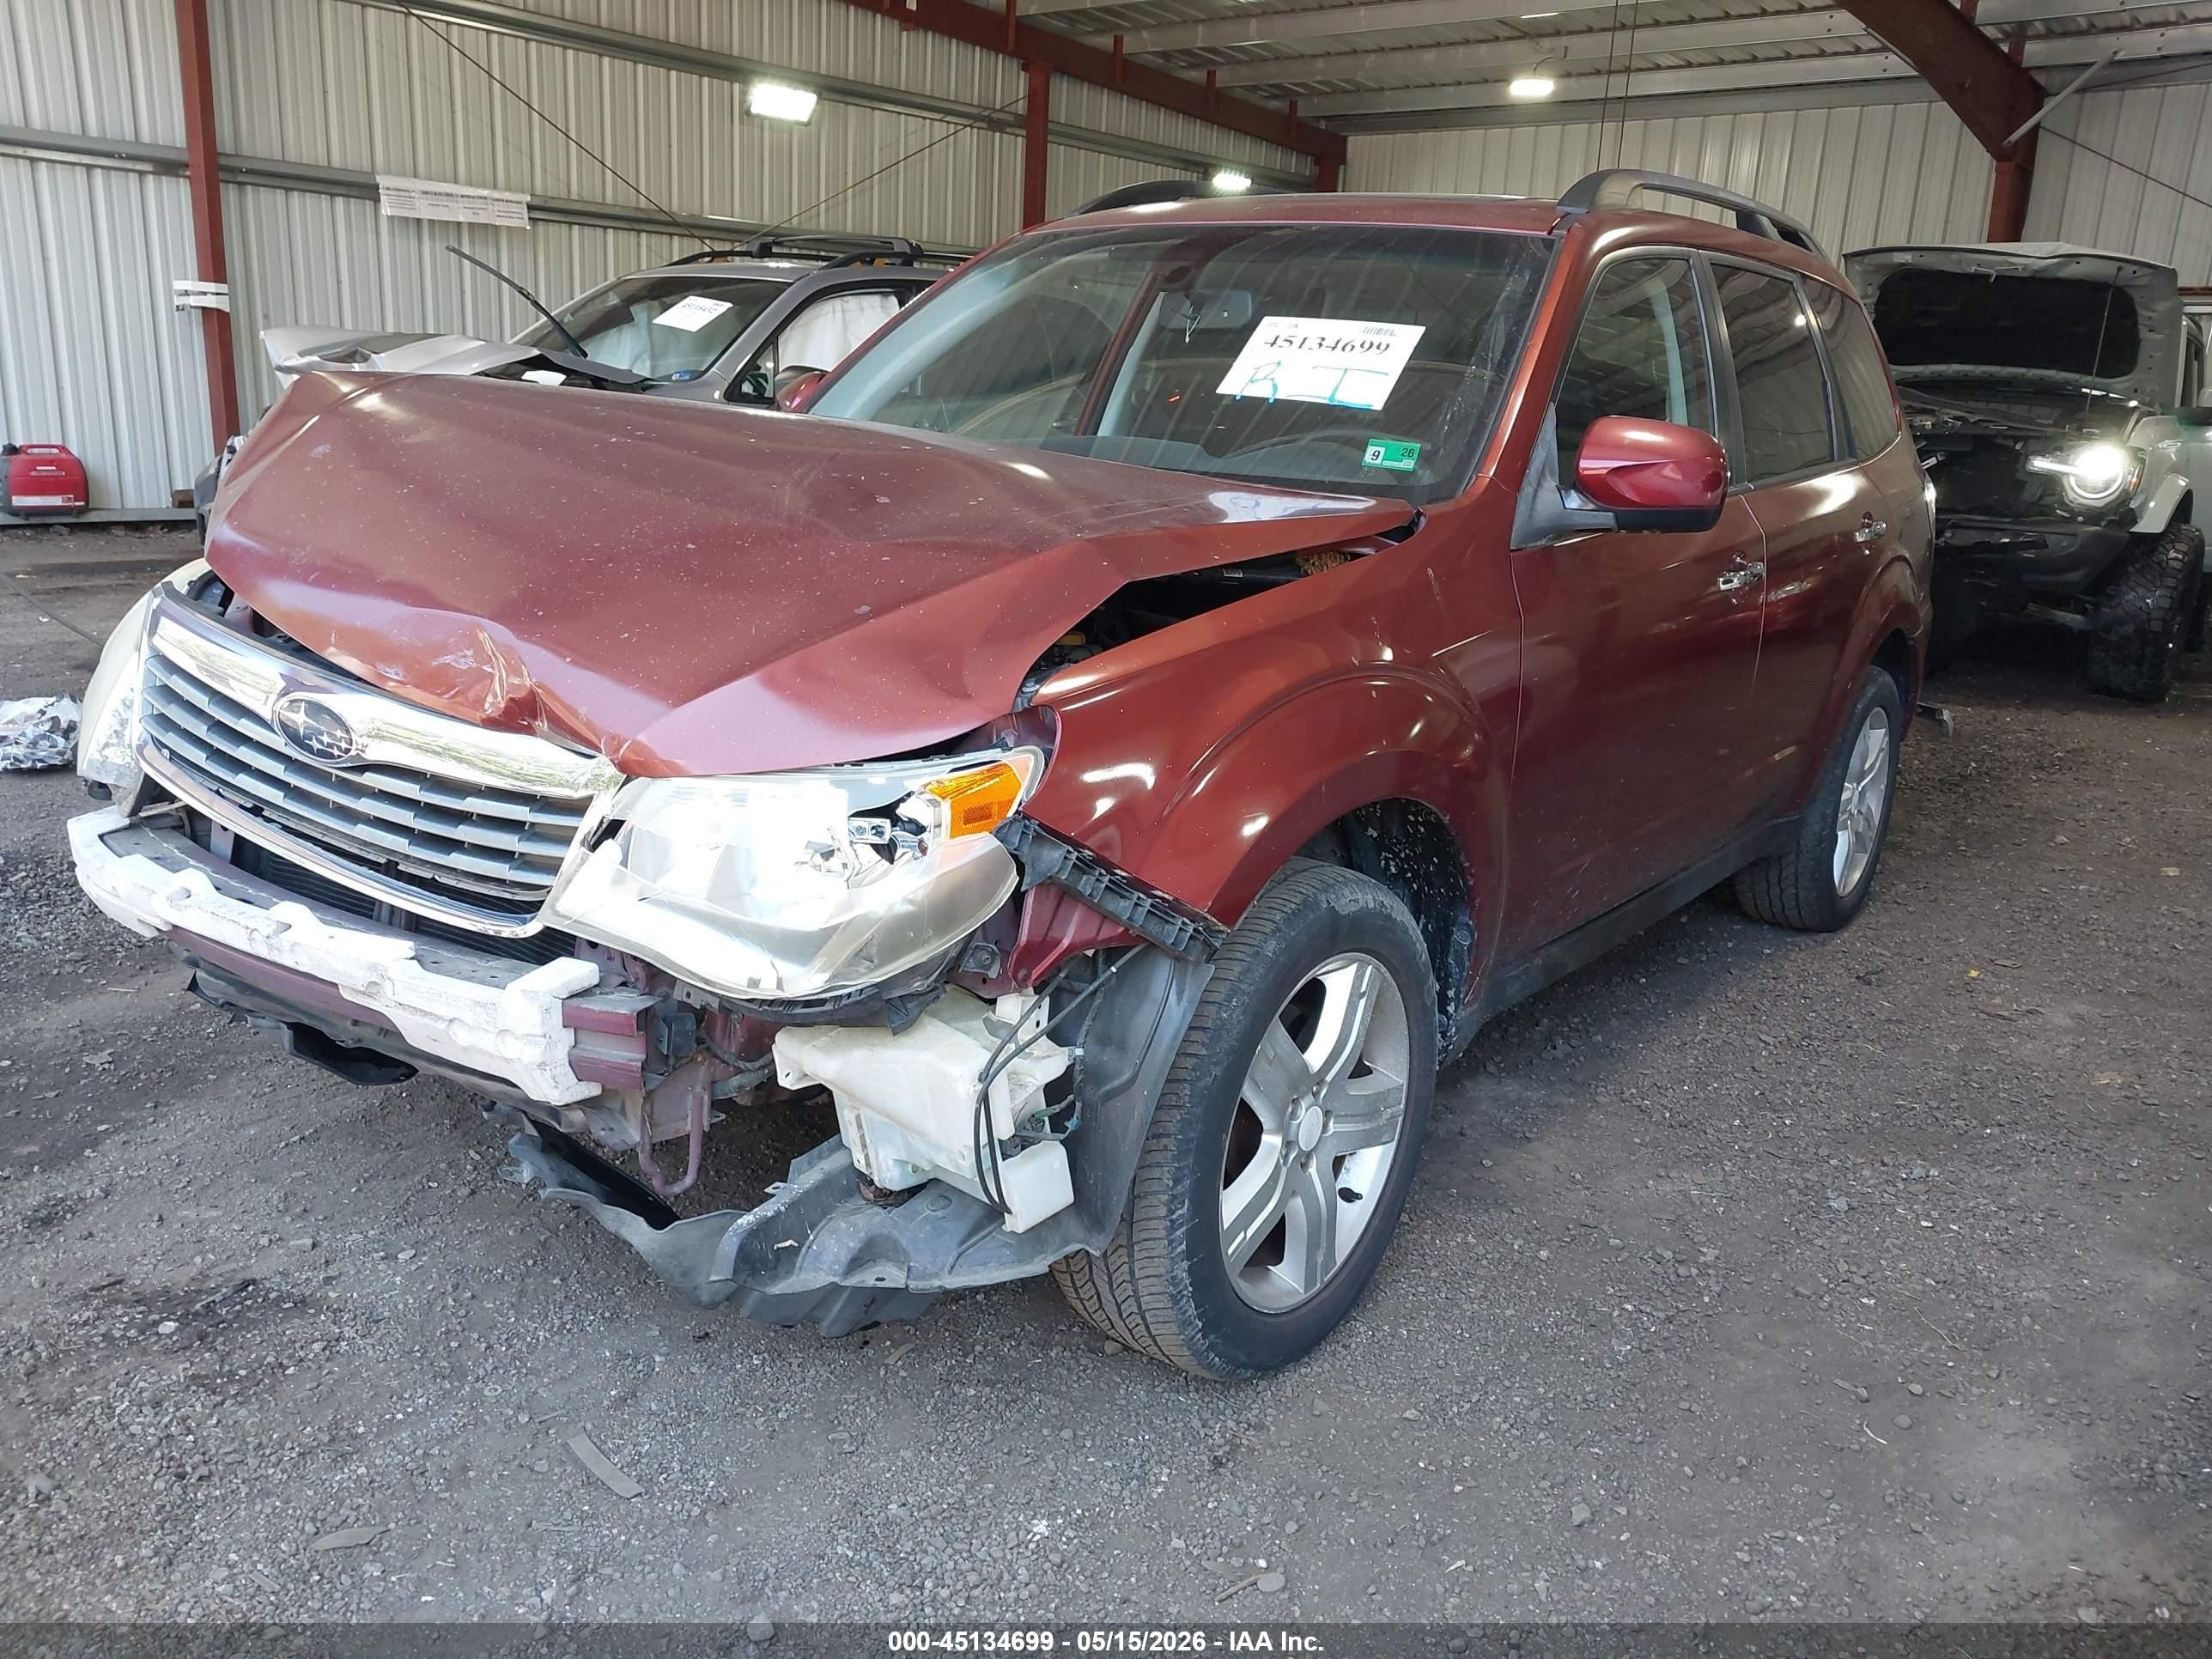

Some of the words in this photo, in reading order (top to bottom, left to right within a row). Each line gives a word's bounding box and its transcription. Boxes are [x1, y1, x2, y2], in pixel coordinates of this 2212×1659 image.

[1263, 333, 1391, 356] 45134699
[1370, 449, 1381, 461] 9
[1401, 447, 1416, 459] 26
